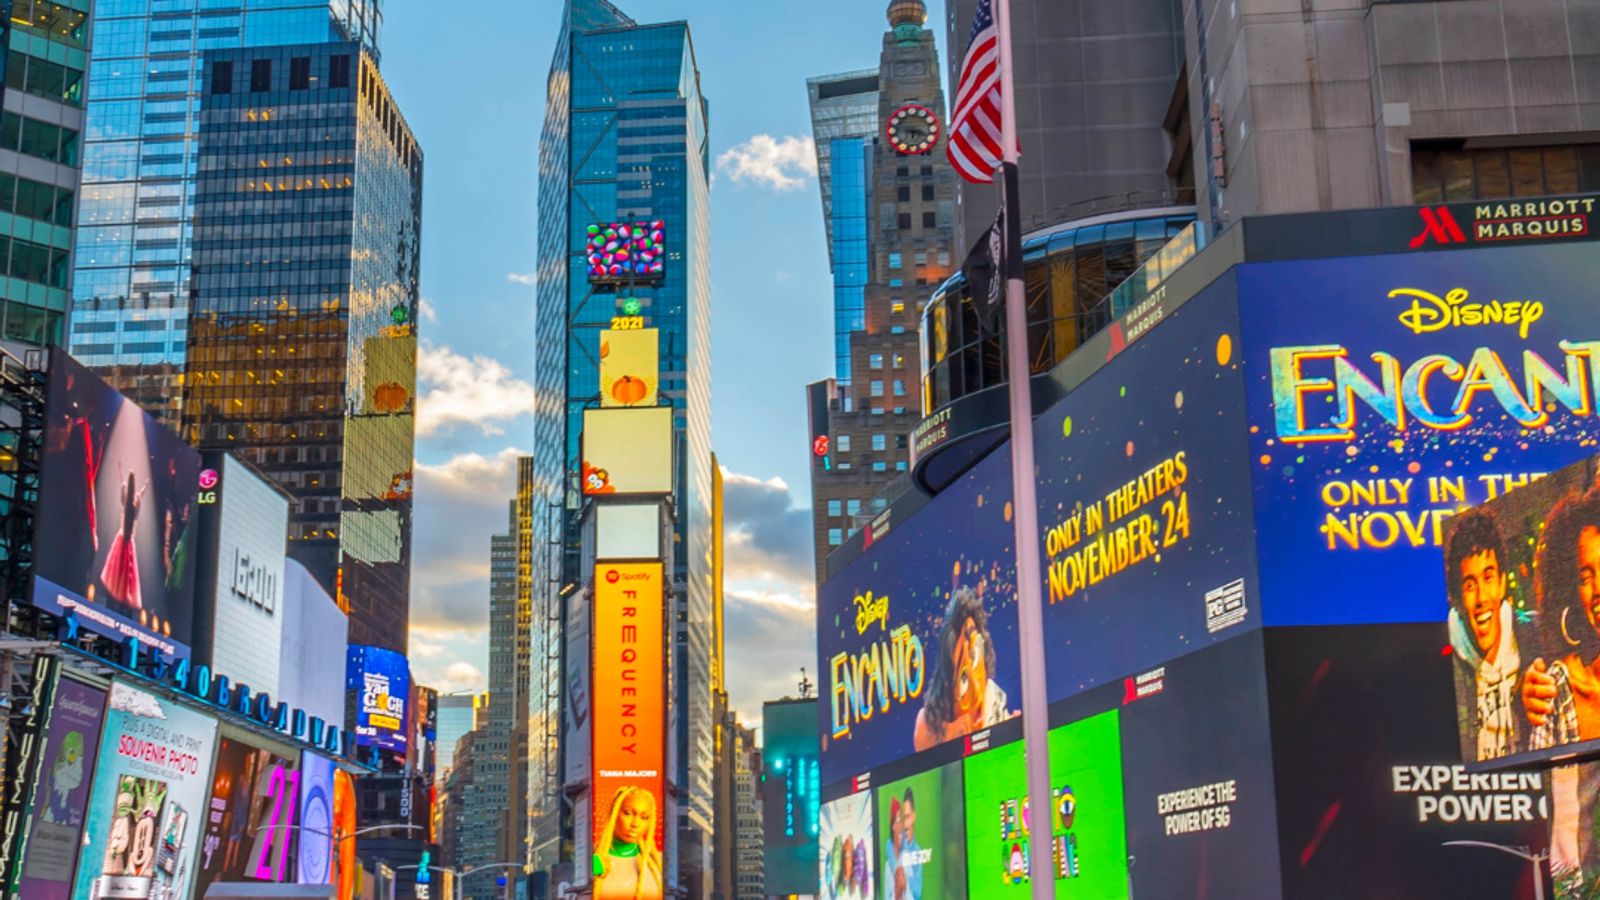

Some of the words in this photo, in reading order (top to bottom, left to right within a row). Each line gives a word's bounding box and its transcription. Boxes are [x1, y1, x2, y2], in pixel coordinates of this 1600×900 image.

[1475, 199, 1595, 220] MARRIOTT
[1478, 218, 1583, 238] MARQUIS
[611, 316, 644, 330] 2021
[1126, 285, 1167, 326] MARRIOTT
[197, 492, 217, 504] LG
[1046, 513, 1082, 557] ONLY
[1086, 500, 1103, 536] IN
[1105, 451, 1188, 523] THEATERS
[1321, 478, 1413, 507] ONLY
[1428, 475, 1467, 503] IN
[1478, 472, 1548, 501] TH
[1161, 491, 1191, 548] 24
[621, 590, 637, 755] FREQUENCY
[831, 624, 924, 739] ENCANTO
[118, 733, 167, 766] SOUVENIR
[168, 749, 199, 776] PHOTO
[1157, 785, 1216, 815] EXPERIENCE
[1215, 779, 1237, 803] THE
[1417, 795, 1534, 822] POWER
[255, 764, 301, 882] 21
[1165, 811, 1201, 836] POWER
[1201, 806, 1215, 830] OF
[1214, 805, 1231, 829] 5G
